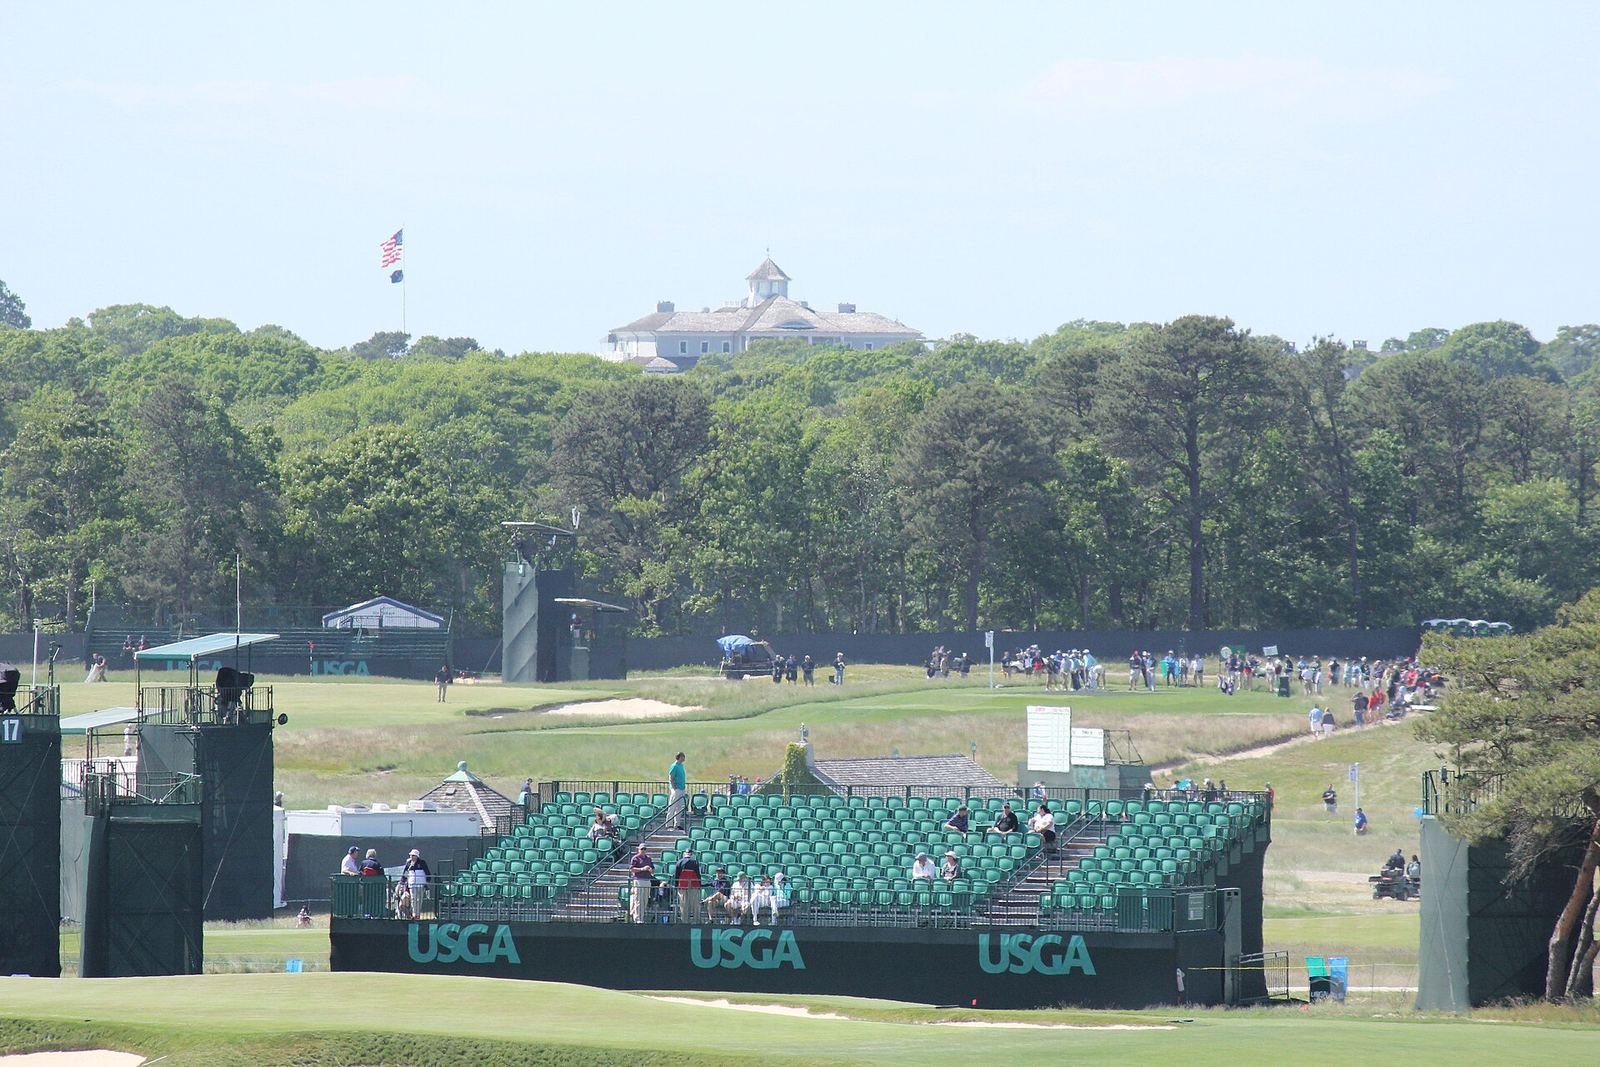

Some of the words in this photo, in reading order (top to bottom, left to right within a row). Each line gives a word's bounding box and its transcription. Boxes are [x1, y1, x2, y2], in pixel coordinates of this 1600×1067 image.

[312, 660, 370, 676] USGA
[2, 719, 19, 741] 17
[407, 923, 521, 964] USGA
[690, 927, 805, 970] USGA
[978, 933, 1096, 976] USGA
